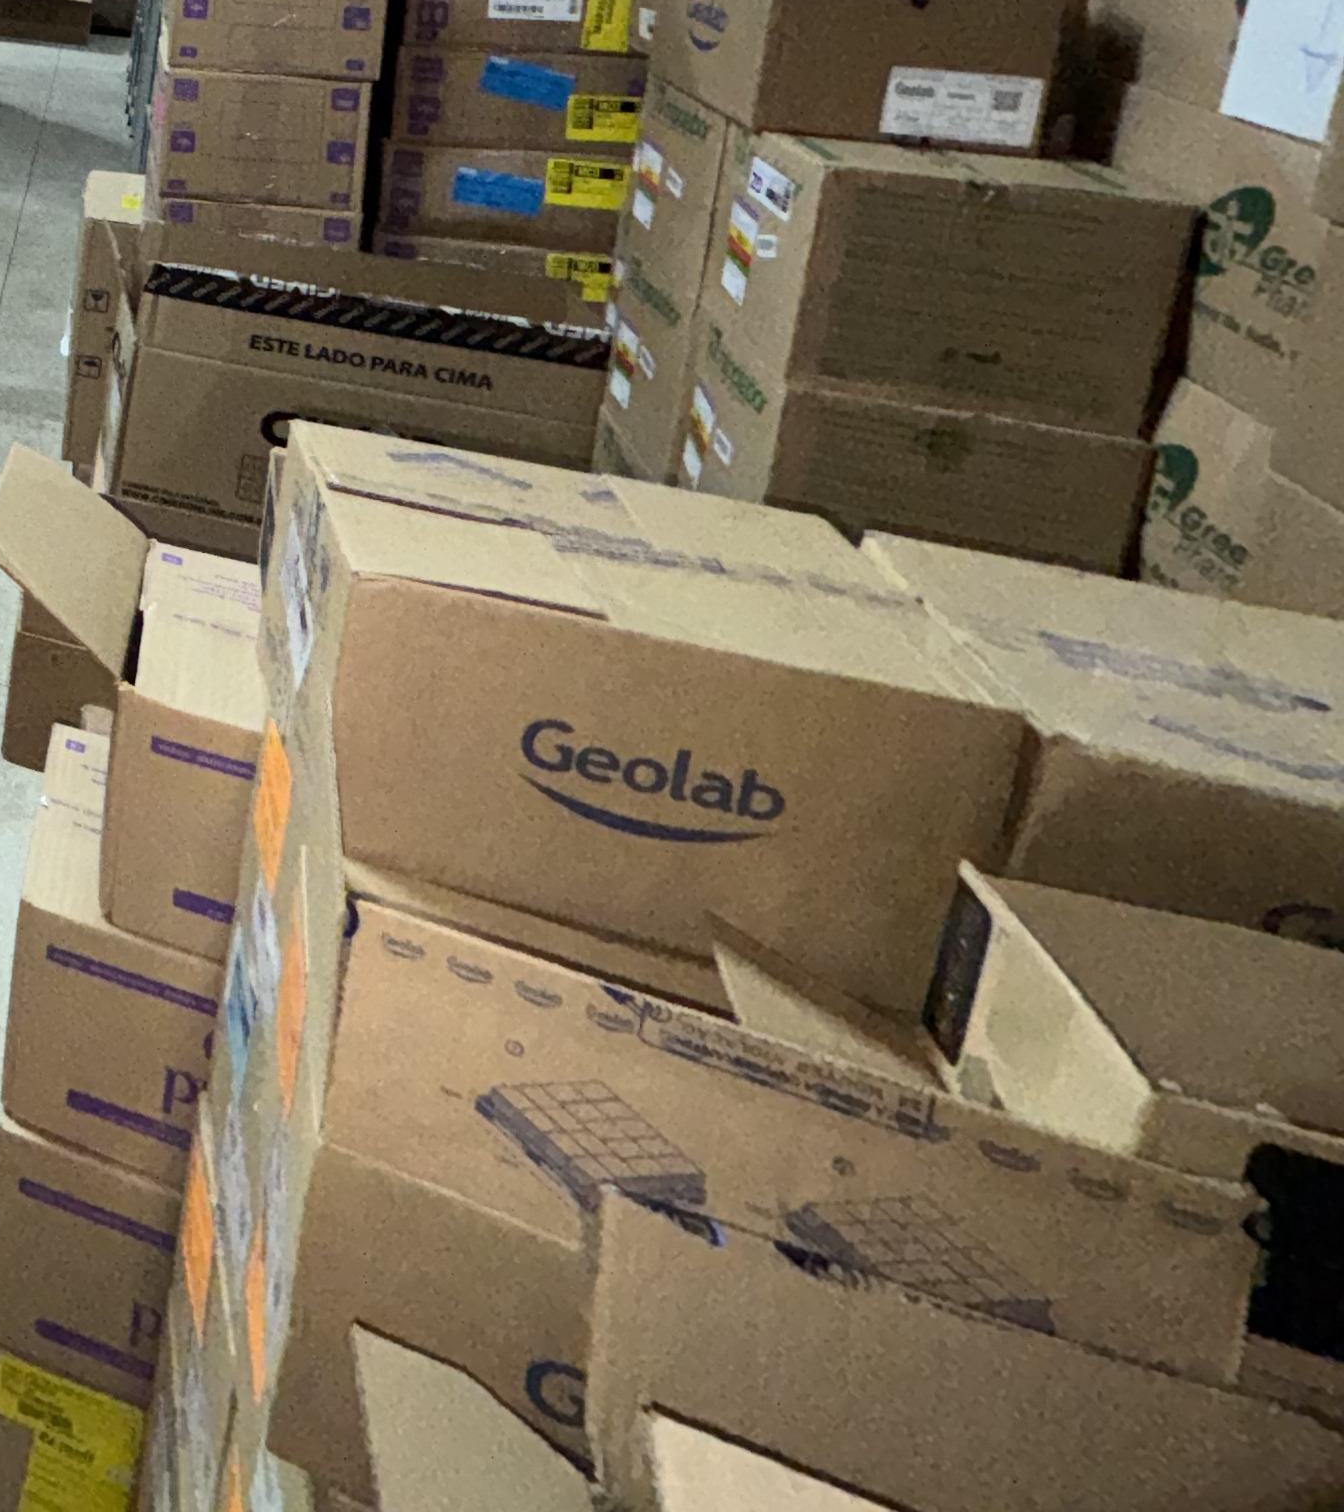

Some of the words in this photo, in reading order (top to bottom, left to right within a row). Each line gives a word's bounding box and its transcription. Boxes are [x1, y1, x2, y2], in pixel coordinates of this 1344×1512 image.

[248, 333, 300, 357] ESTE
[304, 343, 366, 368] LADO
[370, 355, 428, 380] PARA
[434, 366, 494, 391] CIMA
[519, 718, 786, 822] Geolab
